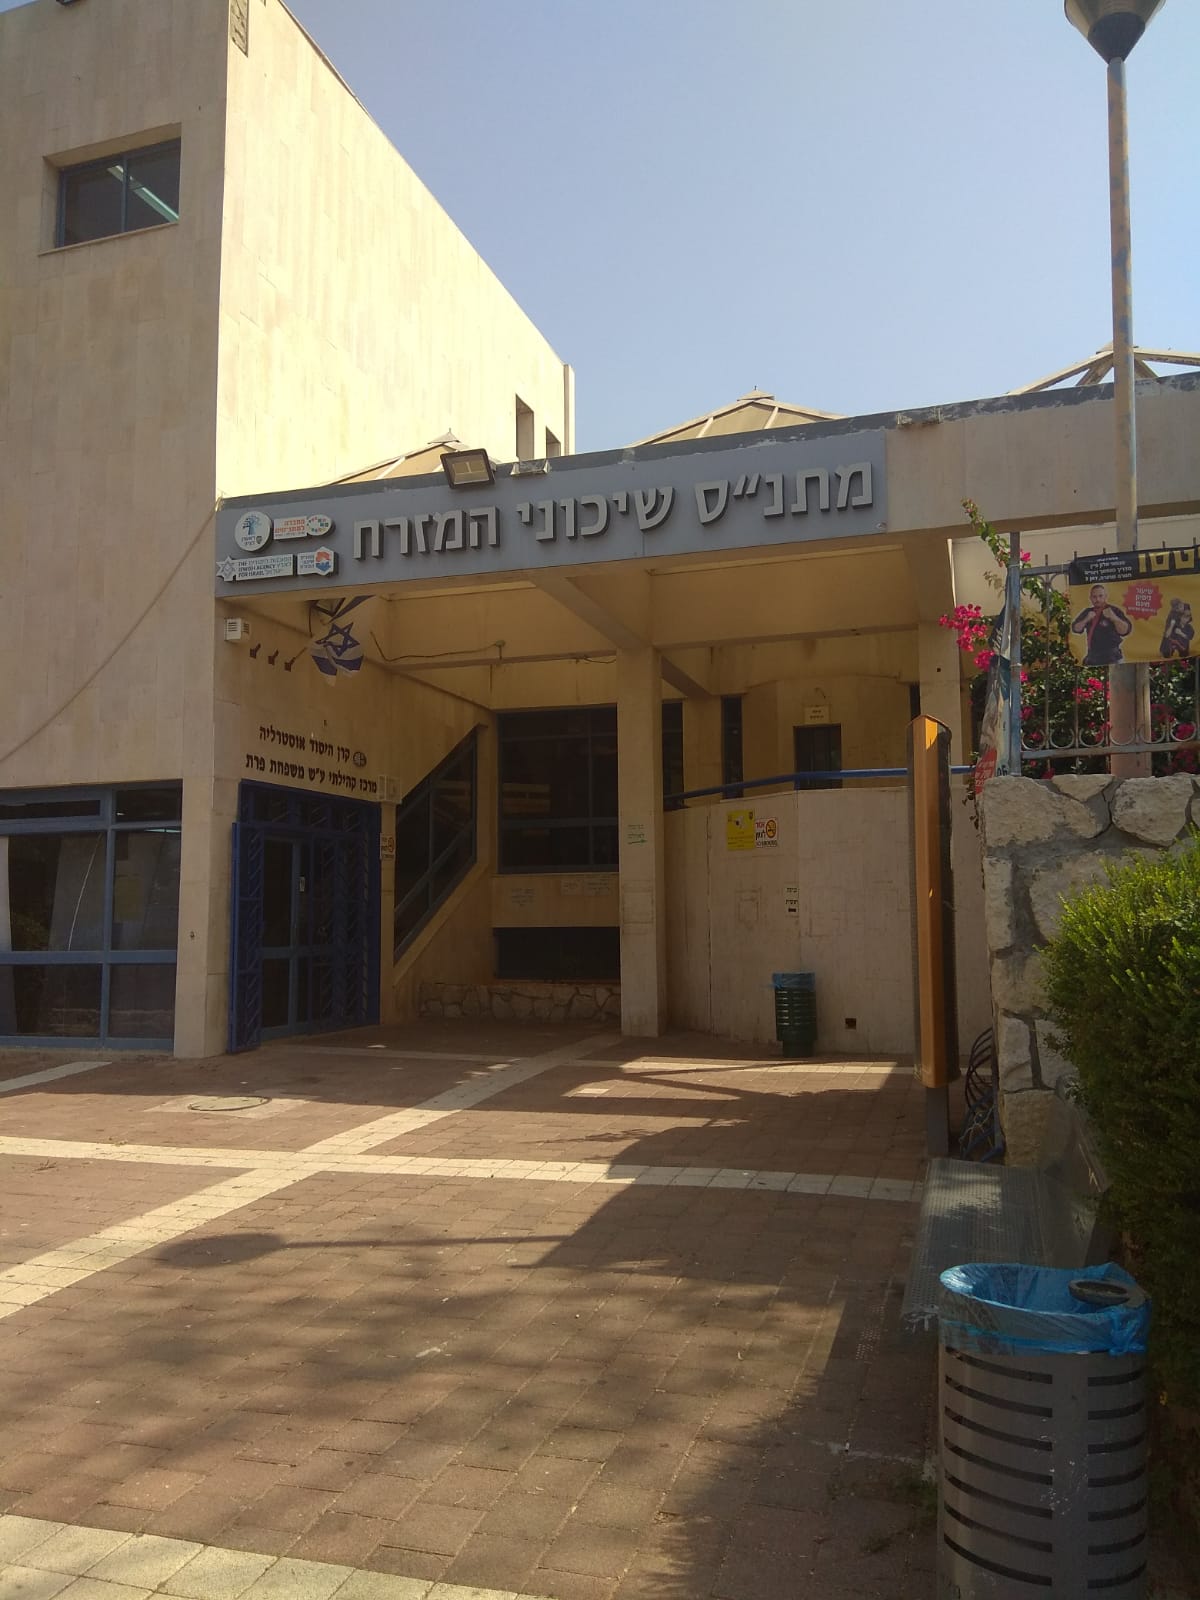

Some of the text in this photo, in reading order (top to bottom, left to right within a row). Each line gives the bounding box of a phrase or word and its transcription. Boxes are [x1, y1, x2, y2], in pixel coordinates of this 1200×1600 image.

[516, 486, 675, 542] שיכוני
[353, 505, 501, 561] המזרח
[259, 725, 351, 763] קרן היסוד אוסטרליה
[246, 753, 266, 772] פרת
[269, 759, 305, 780] משפחת
[329, 770, 356, 792] קהילתי
[359, 778, 377, 793] מרכז
